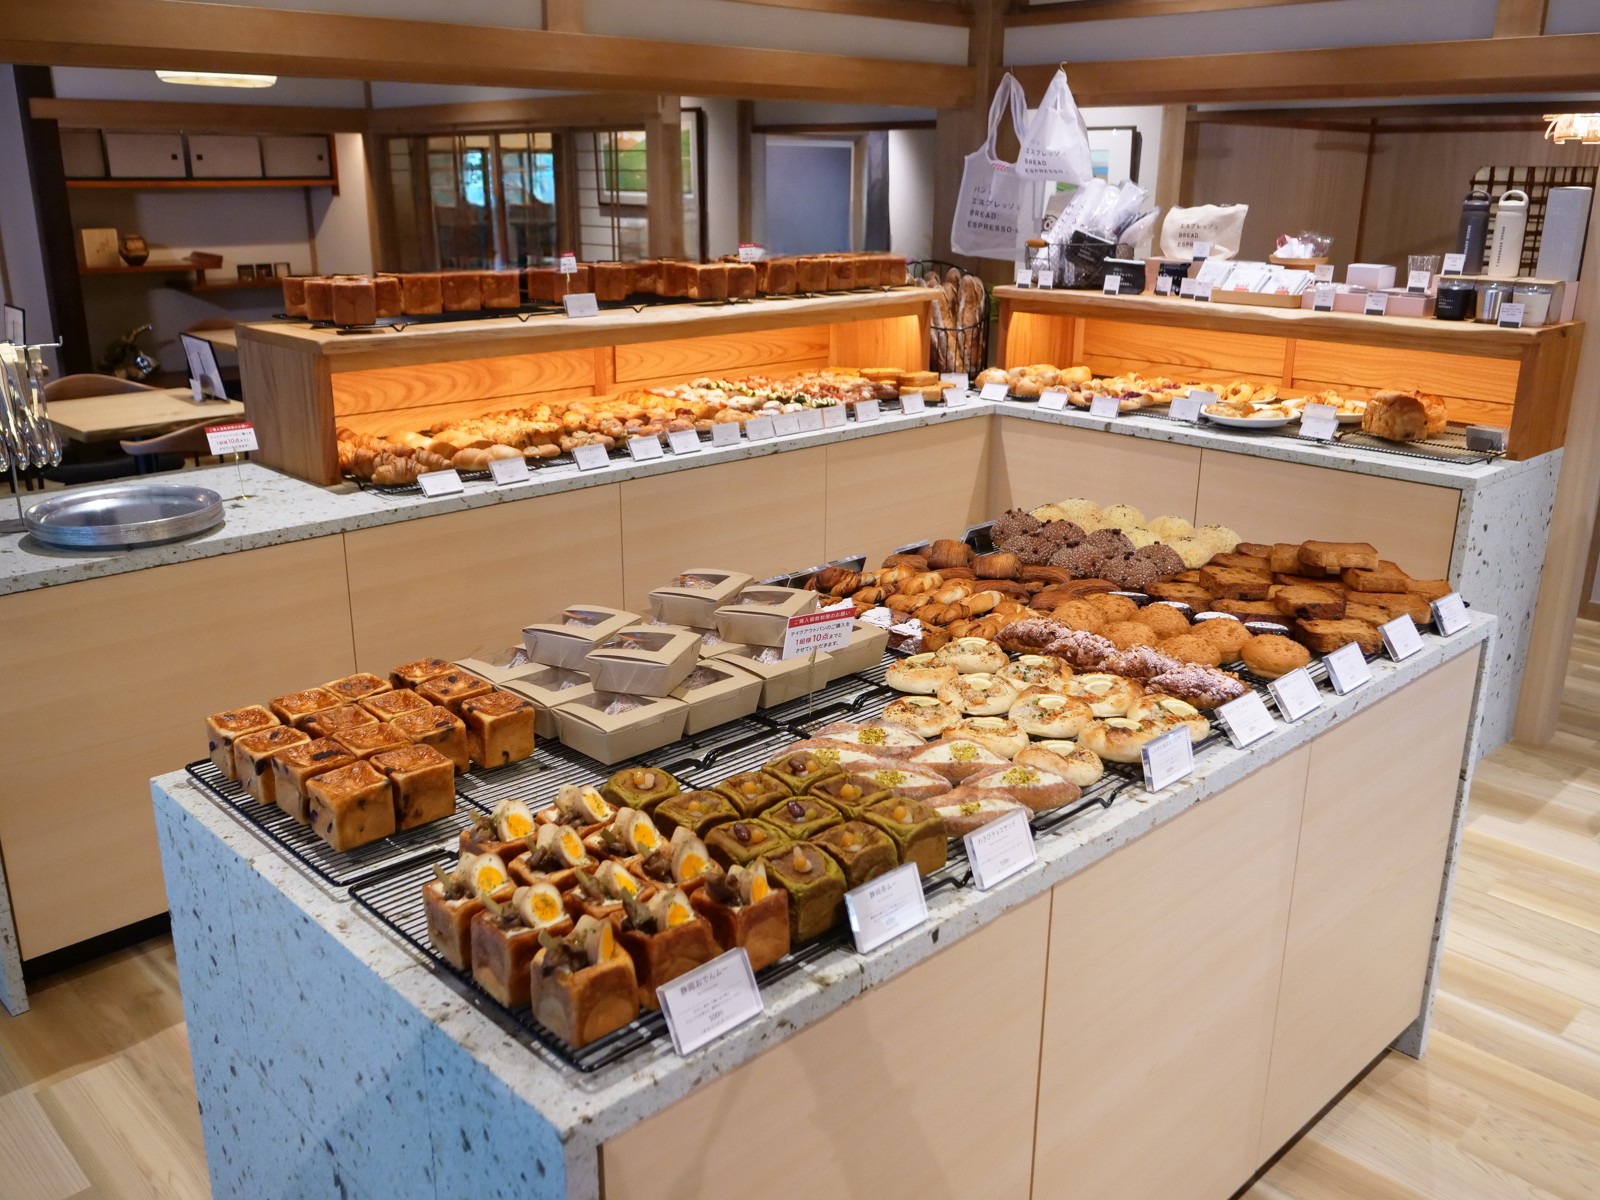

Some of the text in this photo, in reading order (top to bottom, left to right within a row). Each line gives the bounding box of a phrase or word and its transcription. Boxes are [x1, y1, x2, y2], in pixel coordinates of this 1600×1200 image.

[967, 220, 1013, 233] ESPRESSO
[793, 611, 851, 626] ご購入個数制限のお願い
[790, 621, 851, 637] テイクアウトパンのご購入を
